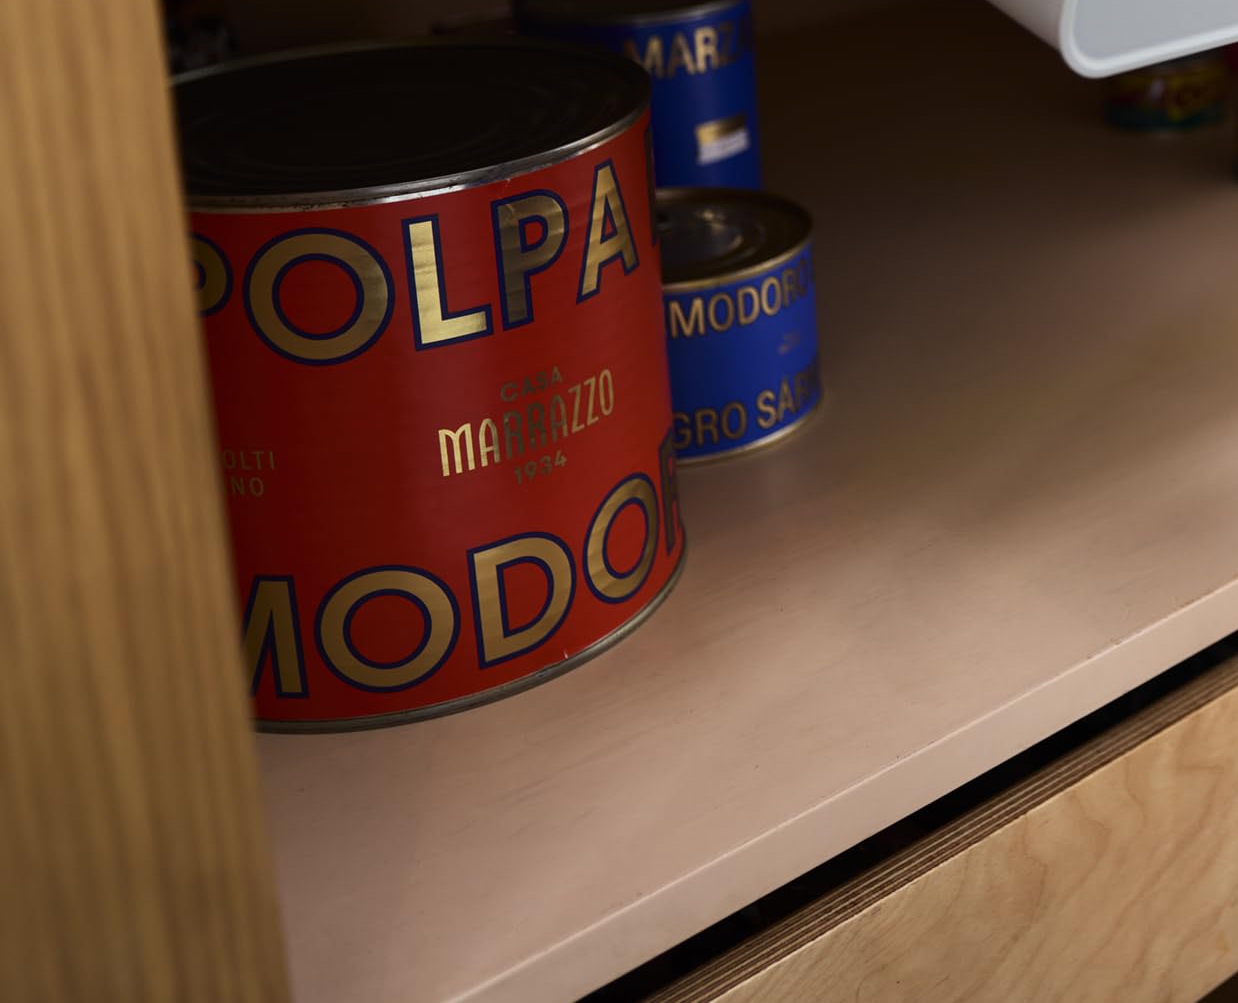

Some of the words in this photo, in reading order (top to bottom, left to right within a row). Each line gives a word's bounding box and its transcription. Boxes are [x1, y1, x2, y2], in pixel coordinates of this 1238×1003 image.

[500, 364, 564, 403] CASA
[438, 368, 615, 477] MARRAZZO
[514, 449, 568, 485] 1934
